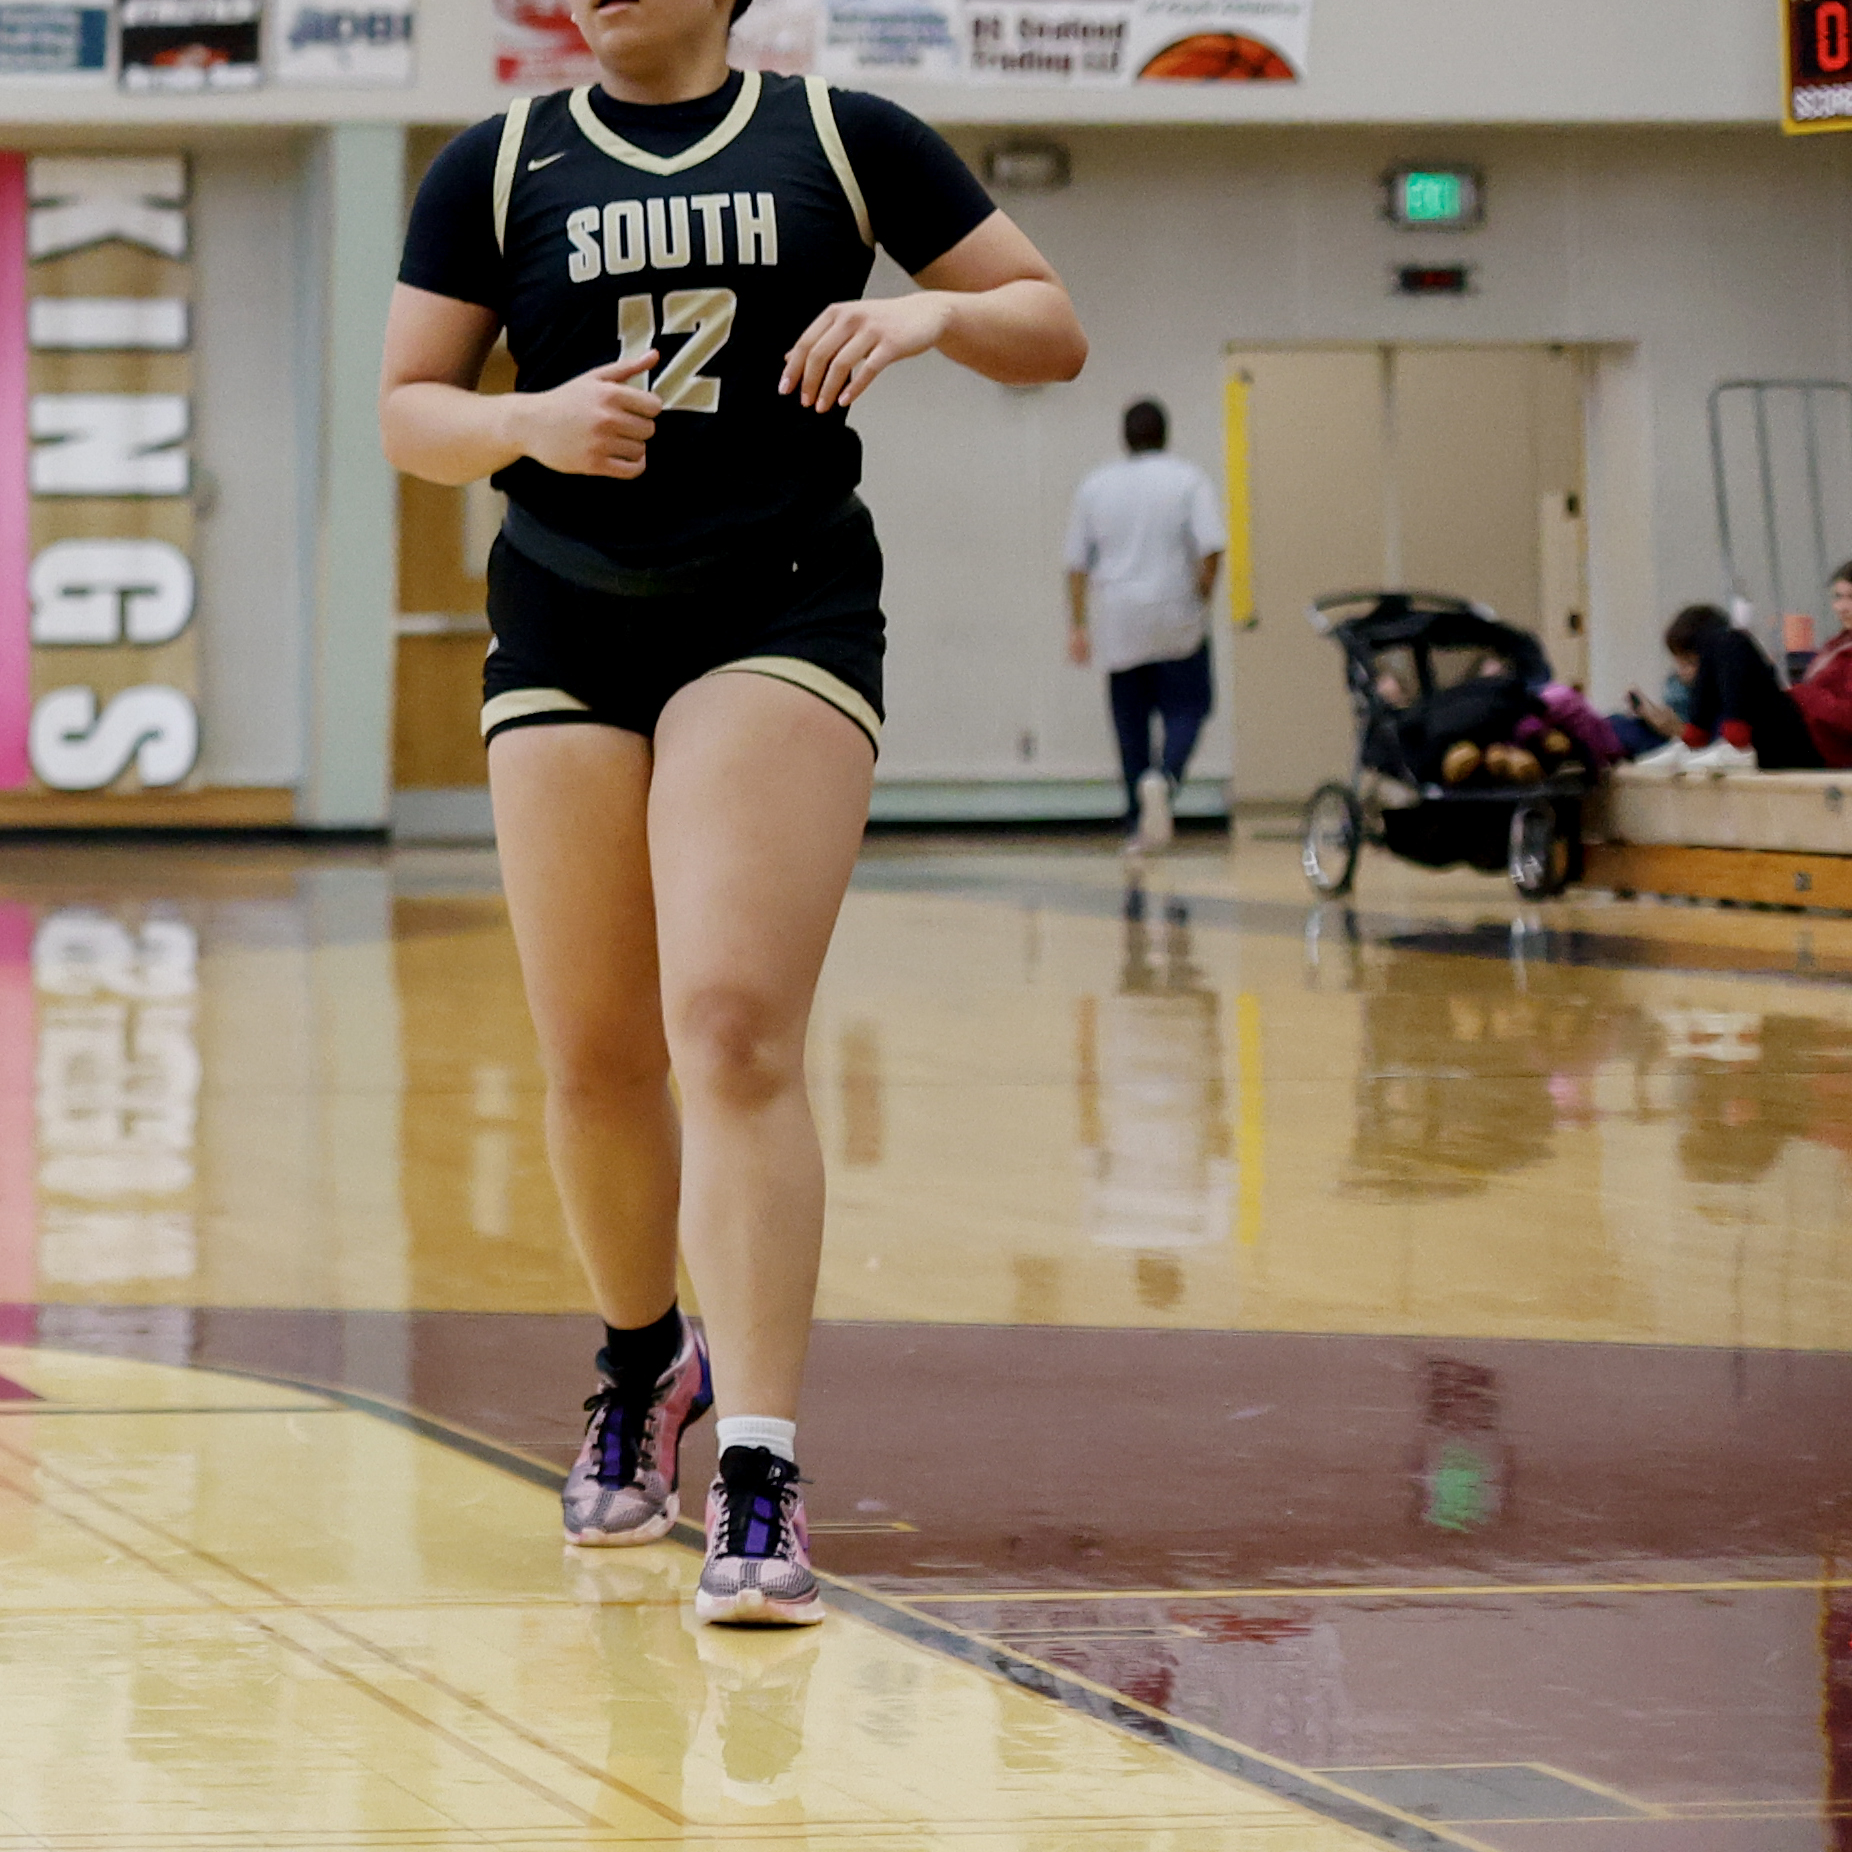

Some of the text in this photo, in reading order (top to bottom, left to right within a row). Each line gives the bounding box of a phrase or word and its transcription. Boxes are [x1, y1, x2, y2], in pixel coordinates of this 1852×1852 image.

[566, 191, 779, 284] SOUTH
[616, 287, 738, 414] 12
[26, 154, 200, 794] KINGS
